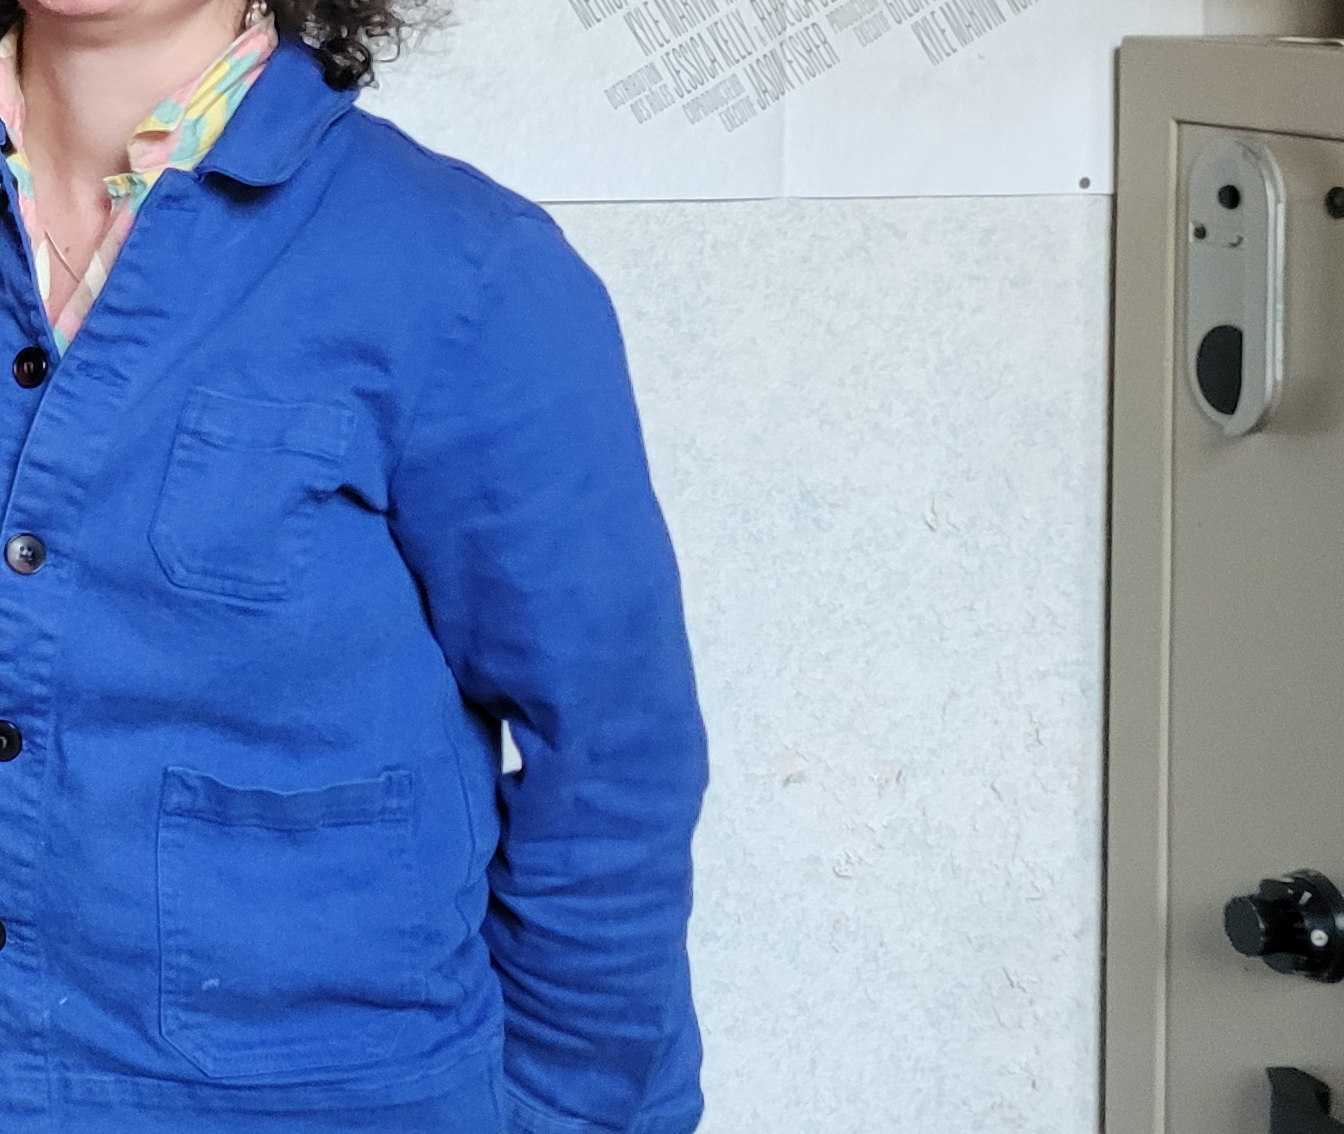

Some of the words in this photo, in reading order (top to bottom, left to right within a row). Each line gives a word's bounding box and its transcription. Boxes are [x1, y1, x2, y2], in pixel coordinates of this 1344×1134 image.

[621, 0, 671, 58] KYLE
[656, 29, 725, 99] JESSICA
[705, 7, 760, 69] KELLY
[739, 47, 798, 111] JASON
[776, 19, 841, 87] FISHER
[909, 9, 958, 67] KYLE
